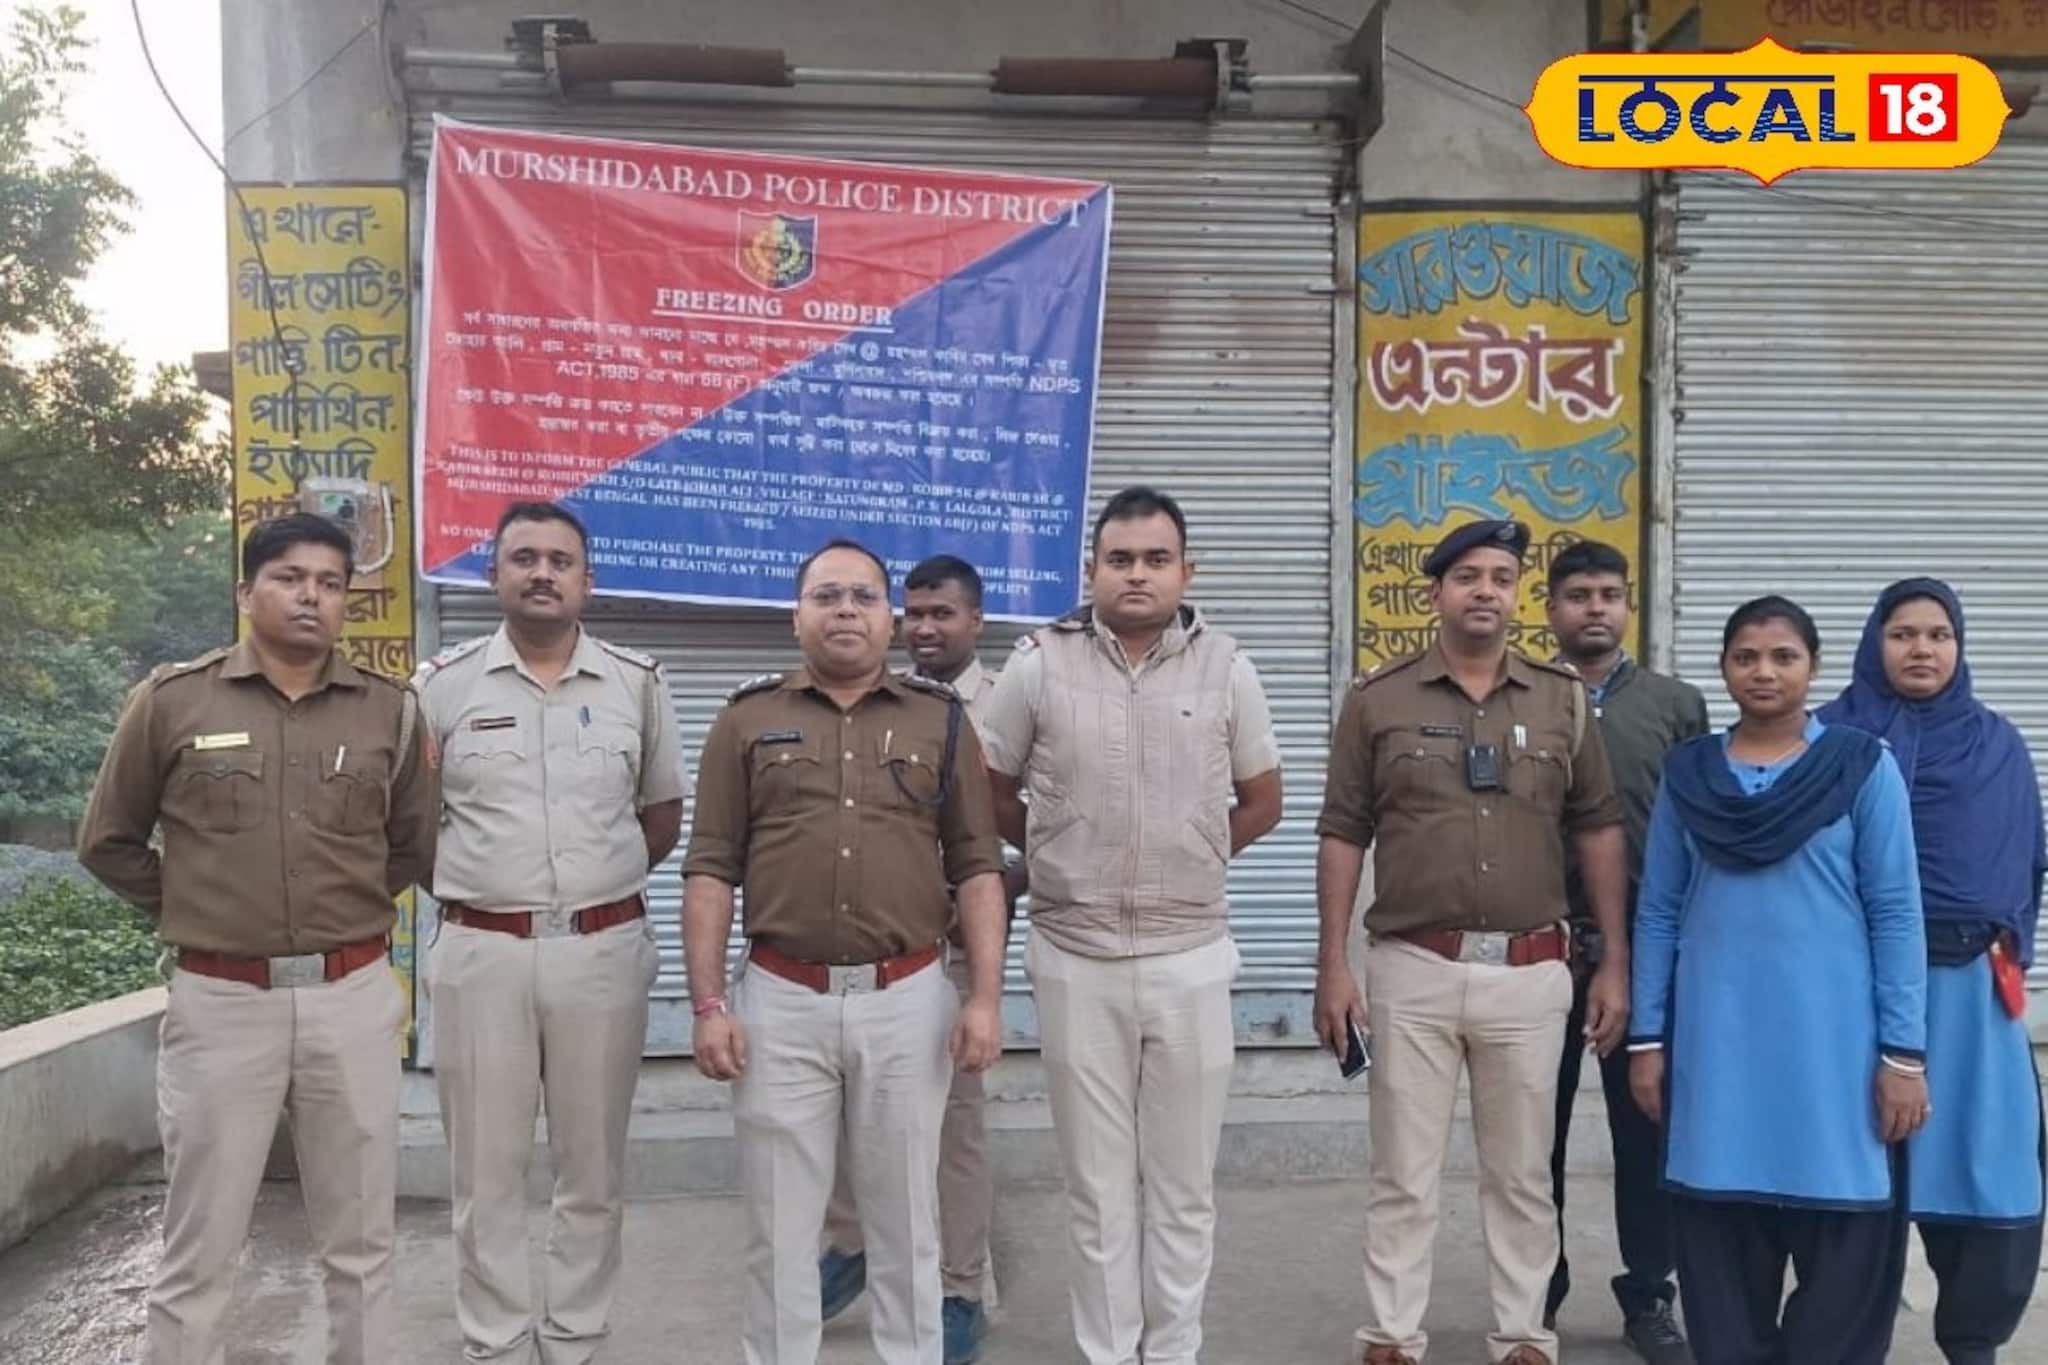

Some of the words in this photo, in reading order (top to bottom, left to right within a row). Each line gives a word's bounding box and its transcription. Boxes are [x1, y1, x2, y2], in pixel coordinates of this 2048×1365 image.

[456, 146, 751, 199] MURSHIDABAD
[763, 173, 902, 213] POLICE
[911, 186, 1089, 228] DISTRICT
[655, 287, 783, 317] FREEZING
[802, 300, 893, 326] ORDER
[1029, 376, 1082, 395] NDPS
[672, 463, 720, 479] PUBLIC
[723, 466, 758, 482] THAT
[760, 471, 788, 485] THE
[791, 474, 859, 492] PROPERTY
[594, 488, 648, 505] BENGAL
[654, 493, 680, 506] HAS
[683, 495, 718, 510] BEEN
[840, 508, 885, 524] UNDER
[887, 512, 942, 530] SECTION
[1037, 523, 1063, 538] ACT
[946, 502, 1001, 518] LALGOLA
[592, 536, 610, 549] TO
[613, 537, 683, 555] PURCHASE
[686, 543, 714, 557] THE
[639, 554, 659, 568] OR
[660, 556, 727, 574] CREATING
[730, 563, 757, 576] ANY
